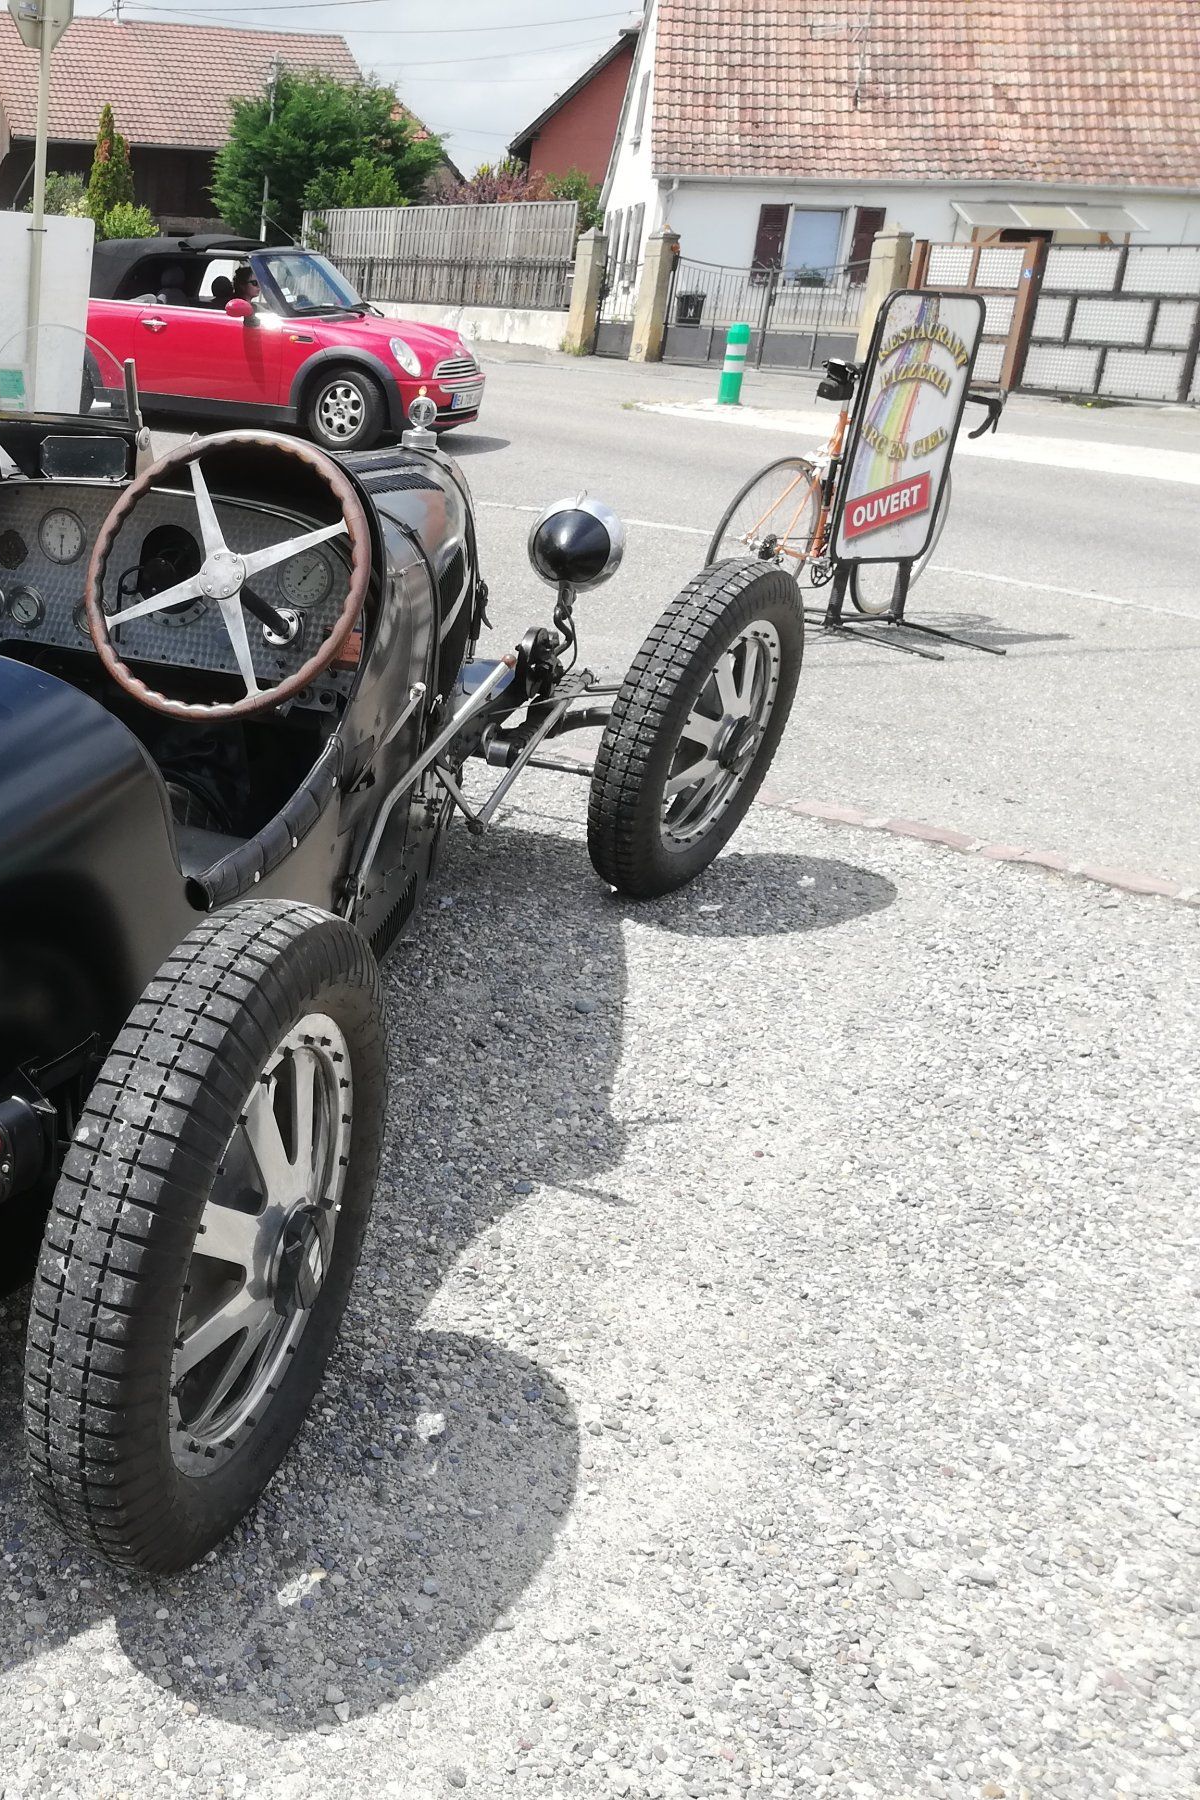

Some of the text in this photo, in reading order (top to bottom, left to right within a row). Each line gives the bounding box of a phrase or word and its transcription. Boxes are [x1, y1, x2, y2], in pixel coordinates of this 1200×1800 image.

[878, 322, 968, 369] RESTAURANT
[881, 362, 951, 397] PIZZERIA
[861, 421, 948, 460] ARC EN CIEL
[852, 484, 922, 527] OUVERT
